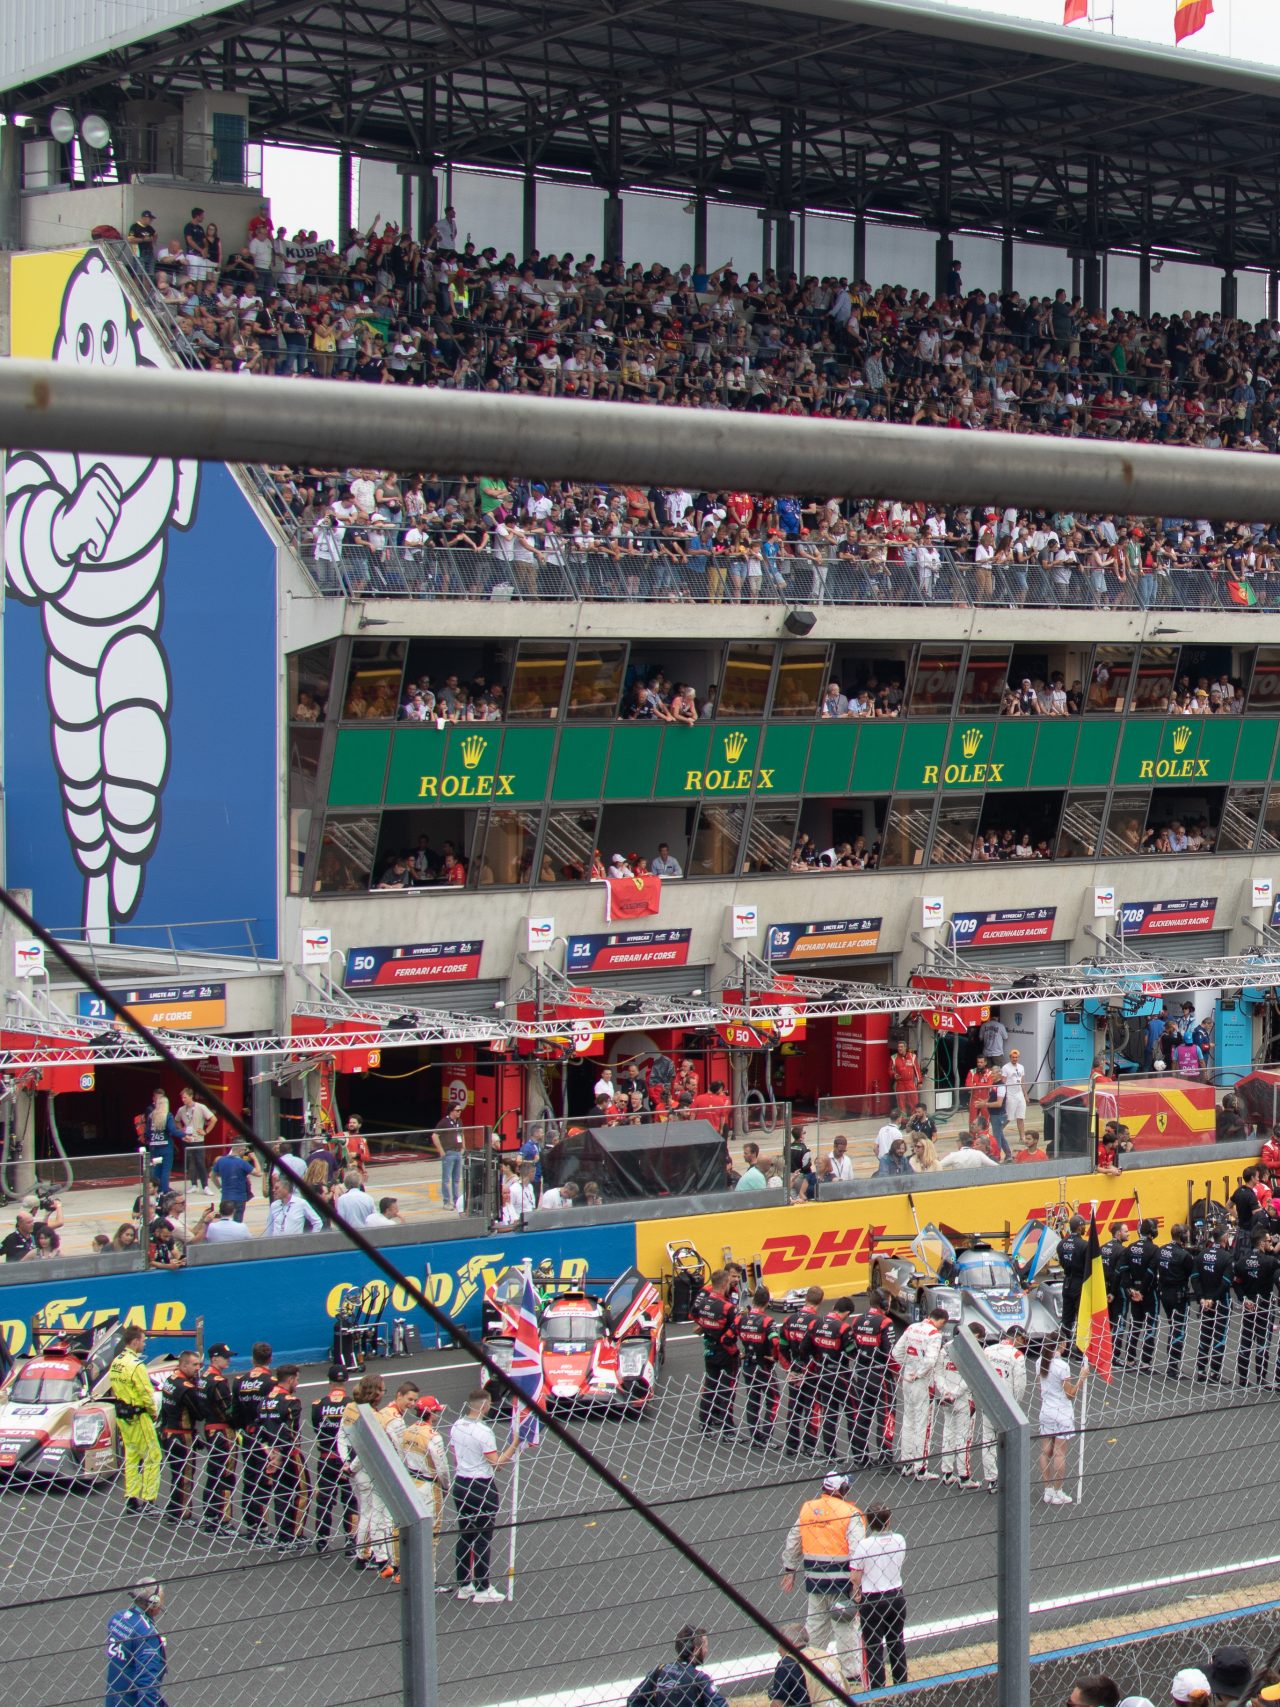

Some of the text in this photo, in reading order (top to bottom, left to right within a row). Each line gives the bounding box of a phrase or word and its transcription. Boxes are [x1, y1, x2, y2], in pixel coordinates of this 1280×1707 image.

[922, 763, 1004, 784] ROLEX
[1139, 759, 1210, 778] ROLEX
[418, 775, 515, 797] ROLEX
[684, 769, 775, 791] ROLEX
[1122, 909, 1144, 922] 708
[1149, 916, 1210, 928] GLICKENHAUS RACING
[954, 919, 978, 933] 709
[774, 931, 791, 946] 83
[983, 927, 1048, 939] GLICKENHAUS RACING
[573, 944, 591, 957] 51
[796, 938, 878, 952] RICHARD MILLE AF CORSE
[354, 956, 375, 970] 50
[610, 952, 677, 964] FERRARI AF CORSE
[395, 964, 468, 977] FERRARI AF CORSE
[90, 1000, 106, 1016] 21
[152, 1010, 193, 1023] AF CORSE
[941, 1016, 954, 1028] 51
[736, 1030, 749, 1042] 50
[370, 1055, 379, 1063] 21
[81, 1077, 92, 1086] 80
[450, 1088, 466, 1100] 50
[761, 1225, 892, 1275] DHL
[240, 1380, 263, 1390] Hertz
[321, 1405, 345, 1415] Hert
